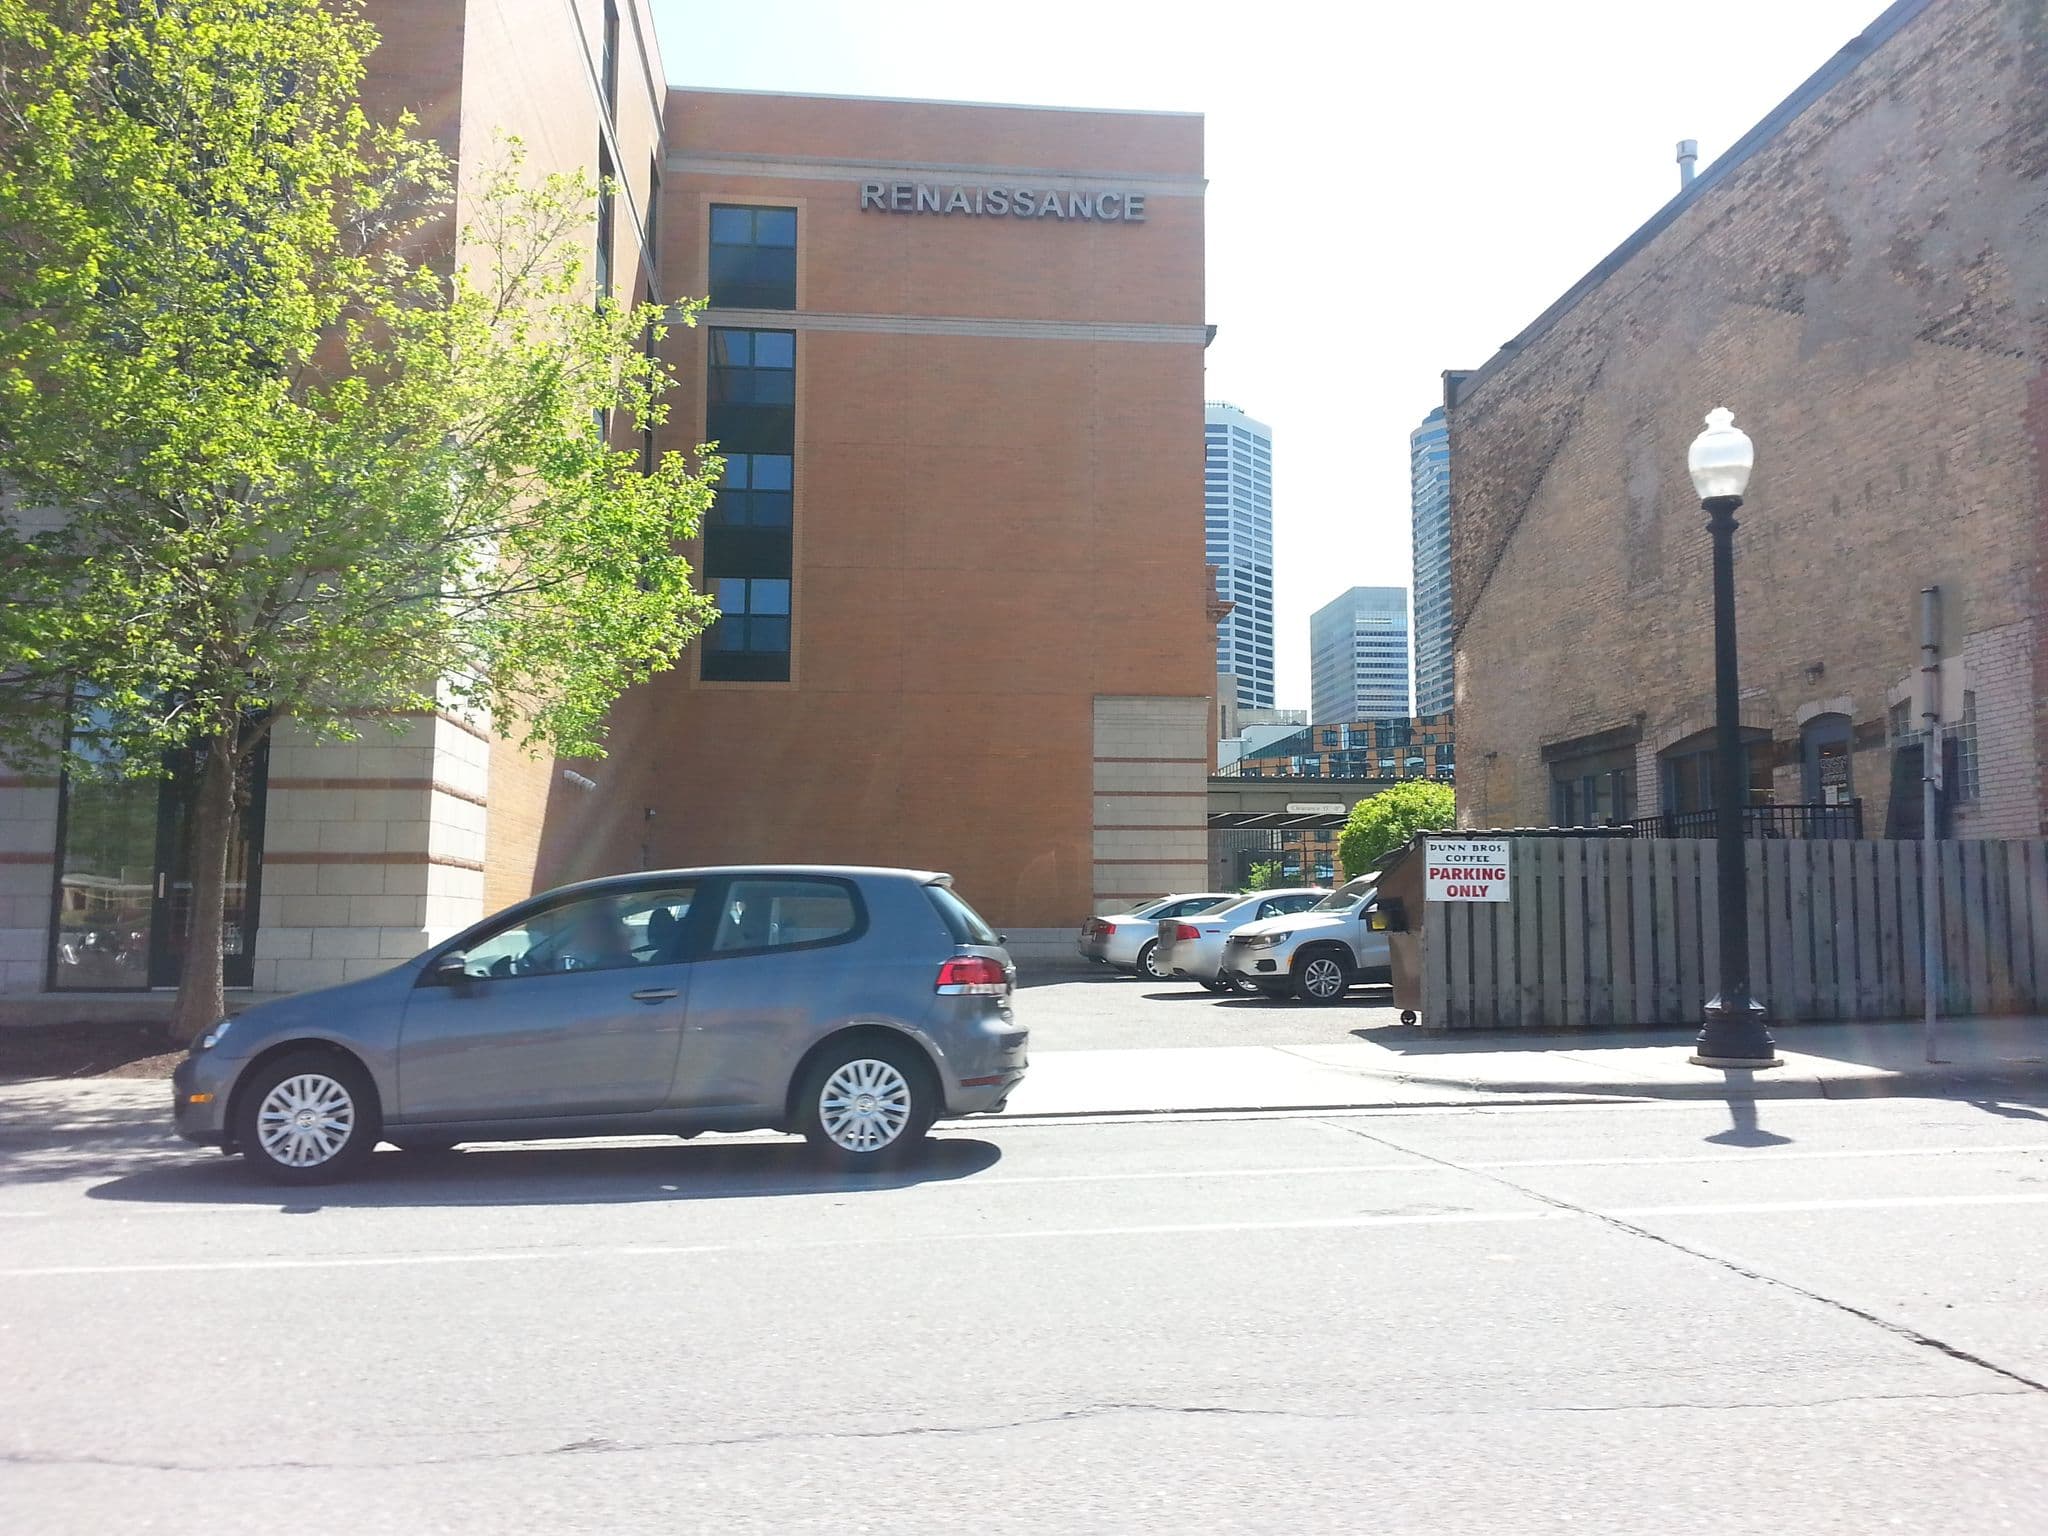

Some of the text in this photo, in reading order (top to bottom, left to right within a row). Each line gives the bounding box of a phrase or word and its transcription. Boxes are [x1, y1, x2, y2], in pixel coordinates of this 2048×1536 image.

[860, 181, 1146, 222] RENAISSANCE
[1430, 844, 1505, 853] DUNN BROS.
[1445, 854, 1490, 863] COFFEE
[1429, 867, 1506, 881] PARKING
[1446, 885, 1489, 897] ONLY
